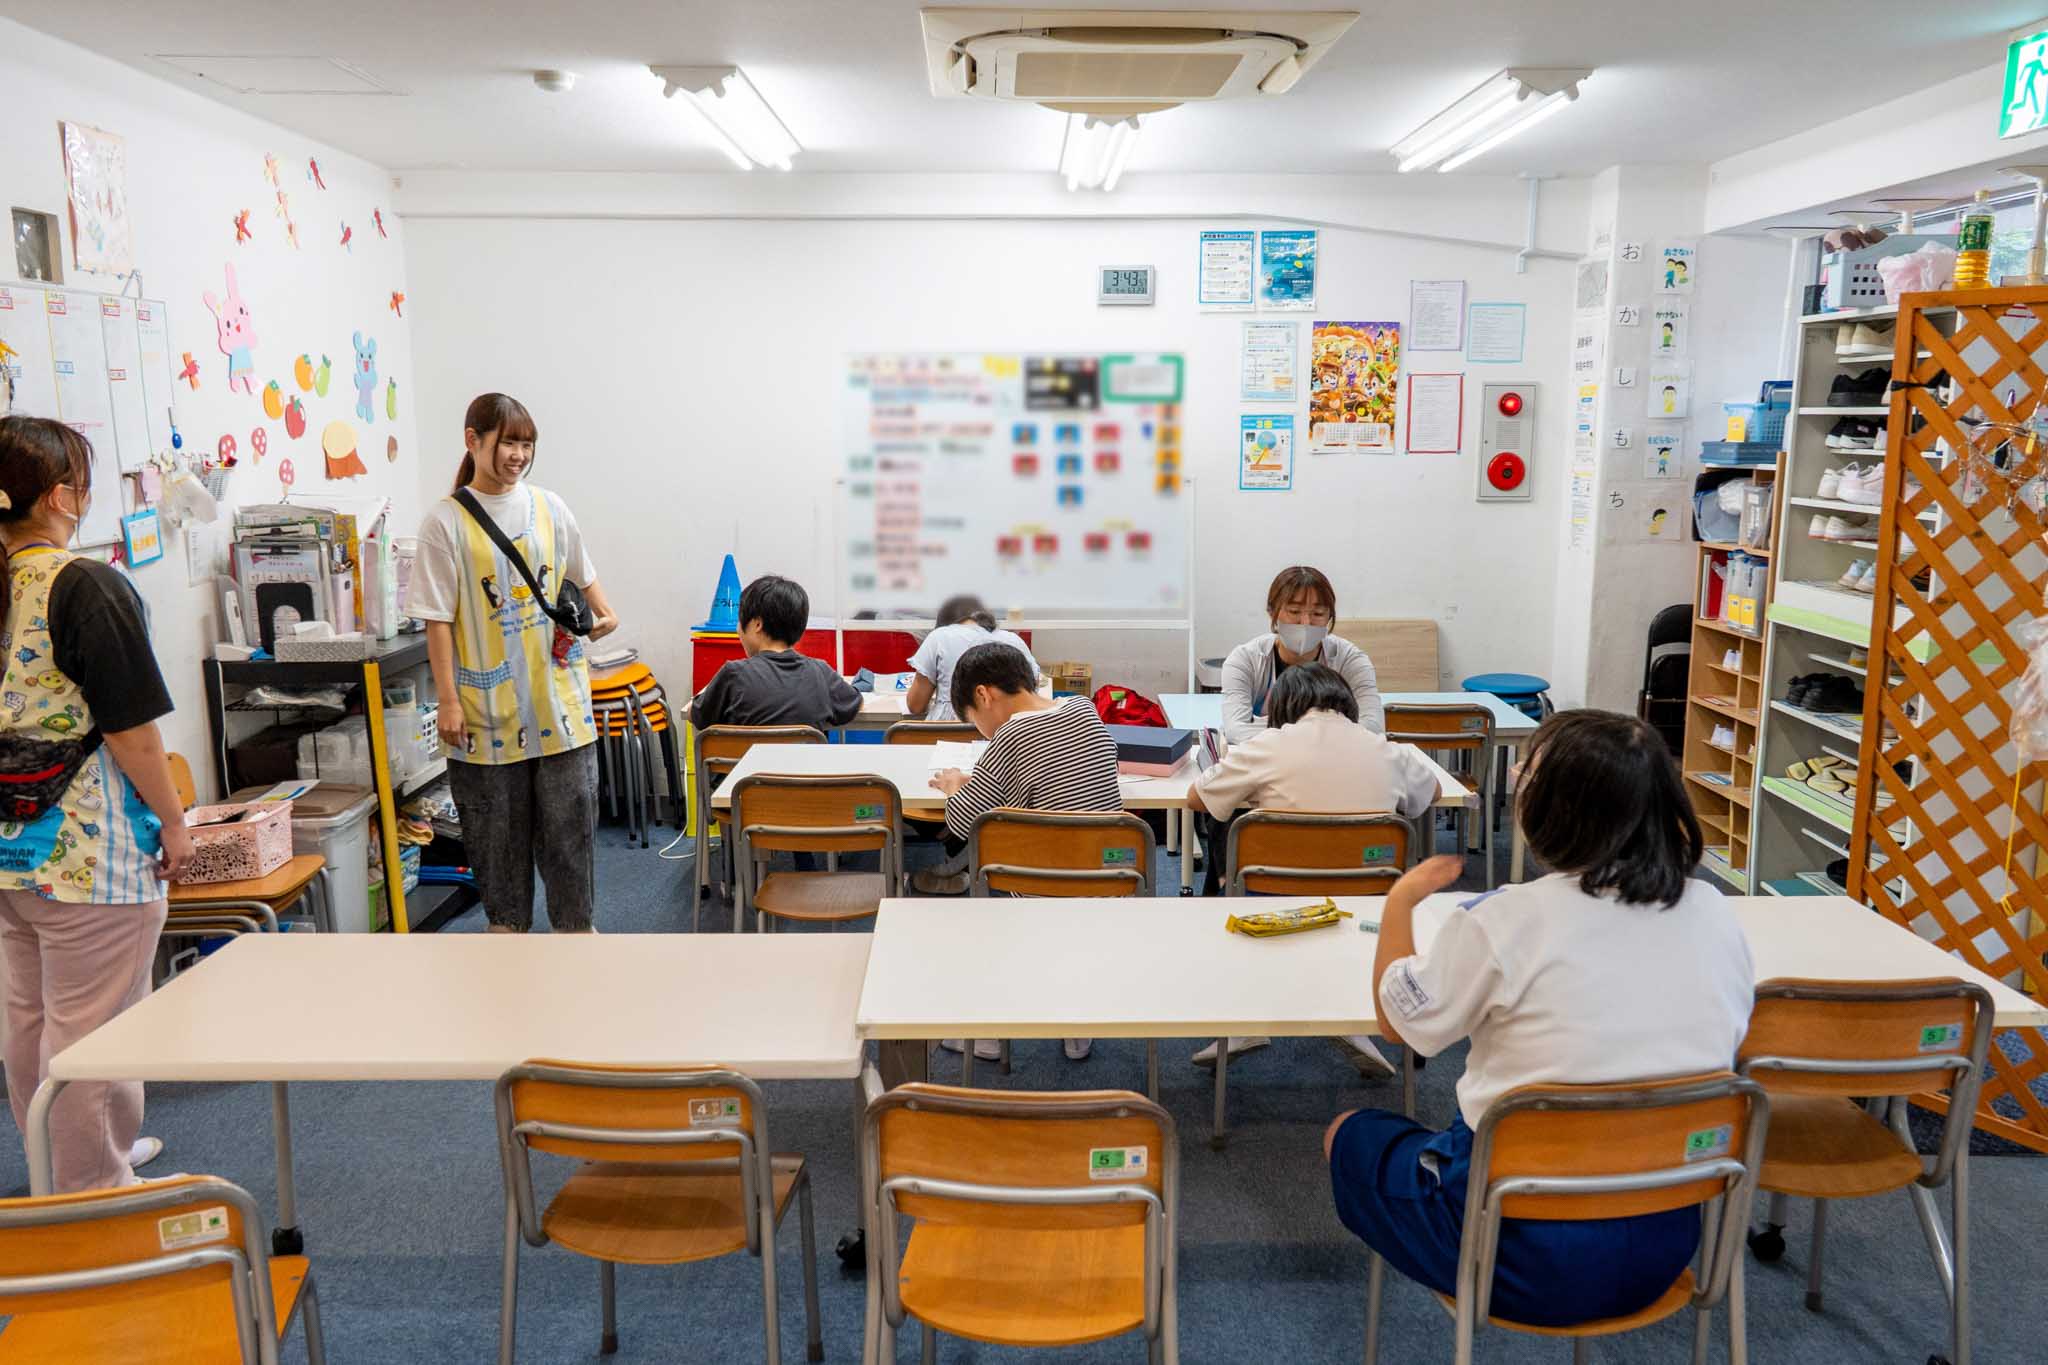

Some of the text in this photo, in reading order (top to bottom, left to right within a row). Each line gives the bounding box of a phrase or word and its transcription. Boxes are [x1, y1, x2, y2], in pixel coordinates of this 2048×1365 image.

[1622, 243, 1640, 260] お
[1111, 271, 1138, 287] 3:43
[1619, 306, 1637, 324] か
[1618, 367, 1632, 386] し
[1614, 429, 1628, 447] も
[1609, 491, 1625, 508] ち
[1927, 1030, 1937, 1041] 5
[1100, 1154, 1110, 1165] 5
